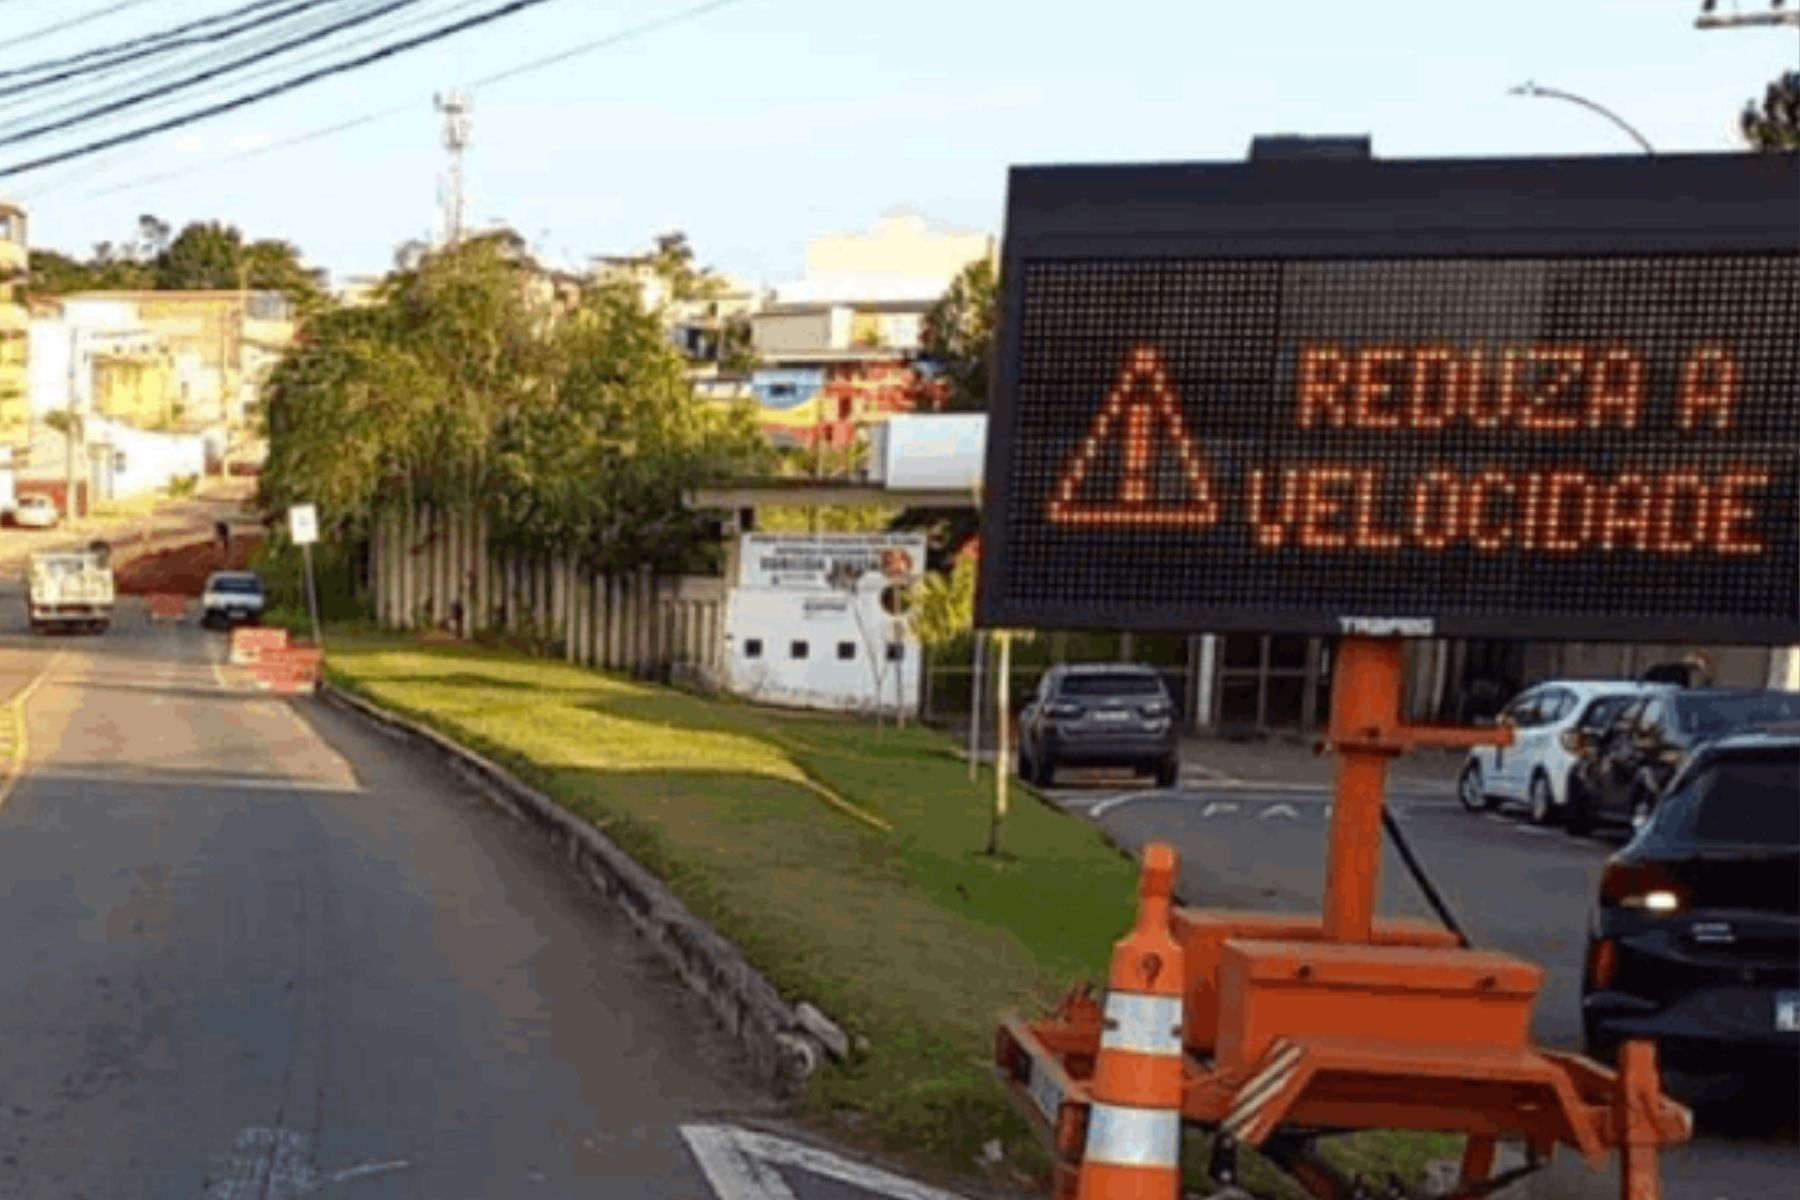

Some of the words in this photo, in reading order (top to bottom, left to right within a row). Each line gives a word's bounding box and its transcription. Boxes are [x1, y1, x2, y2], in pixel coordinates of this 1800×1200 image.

[1298, 346, 1642, 430] REDUZA
[1680, 346, 1738, 430] A
[1247, 468, 1770, 554] VELOCIDADE
